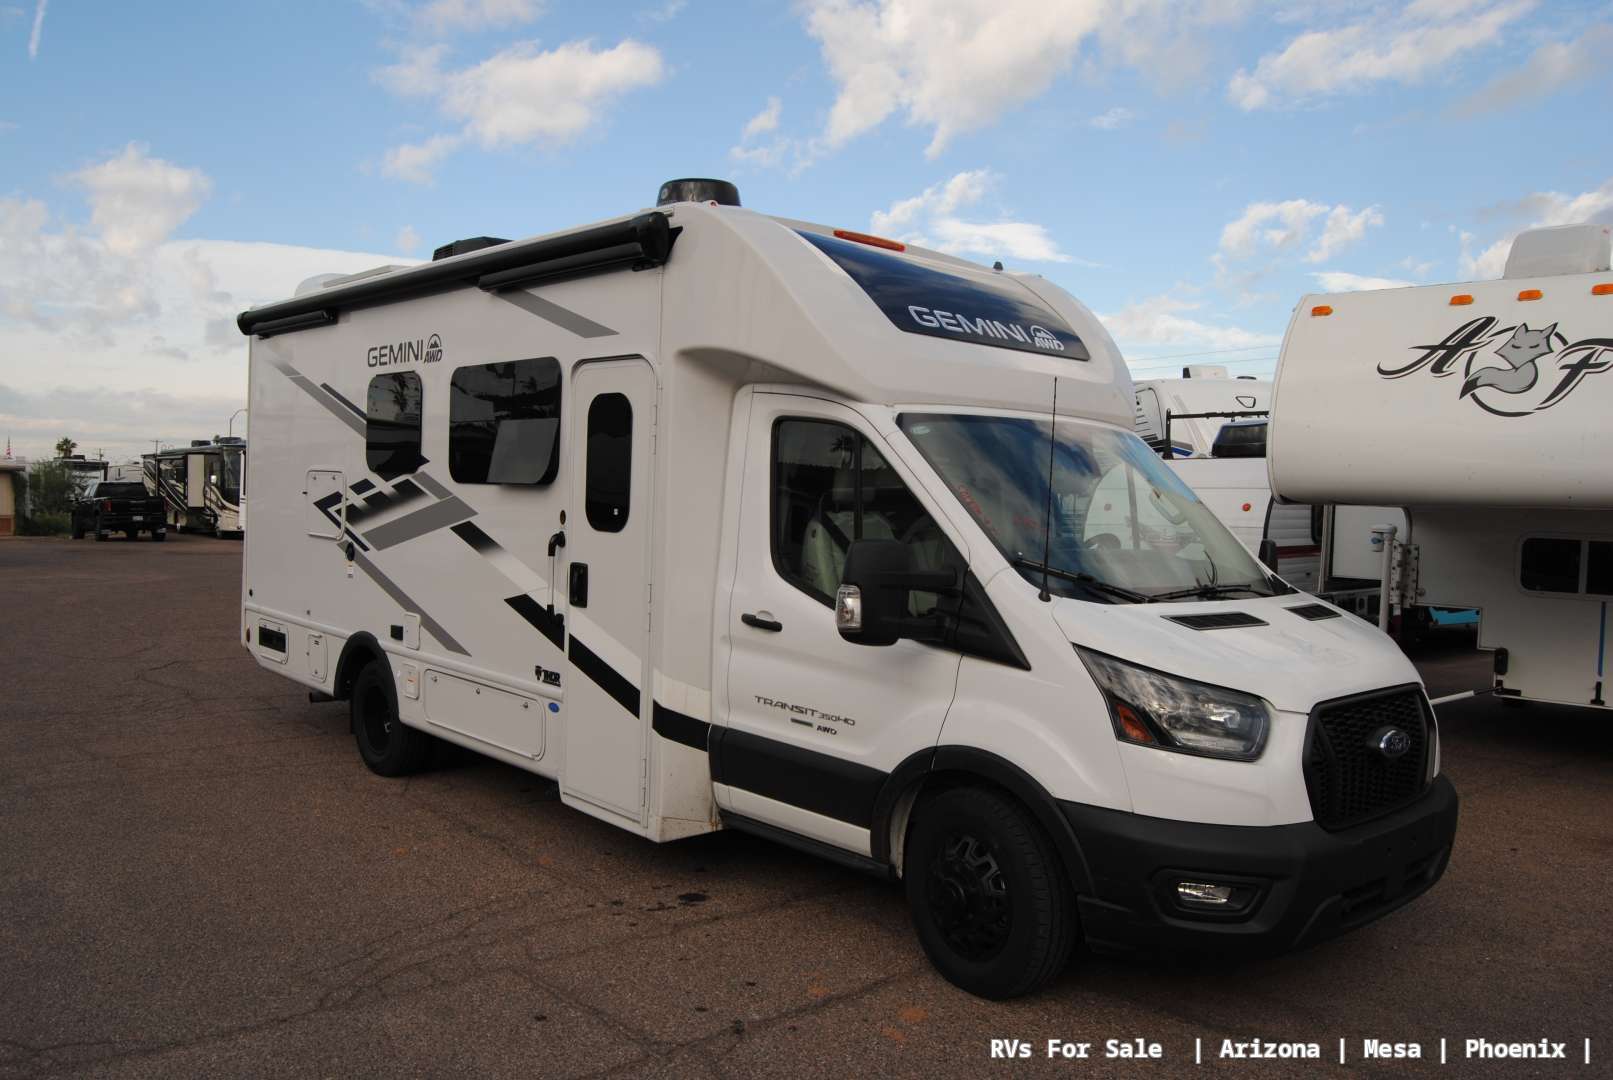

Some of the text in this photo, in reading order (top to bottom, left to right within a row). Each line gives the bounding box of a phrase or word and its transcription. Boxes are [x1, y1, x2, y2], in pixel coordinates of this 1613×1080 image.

[908, 305, 1065, 351] GEMINI AWD
[368, 340, 443, 368] GEMINI AWD
[816, 725, 837, 735] AWD
